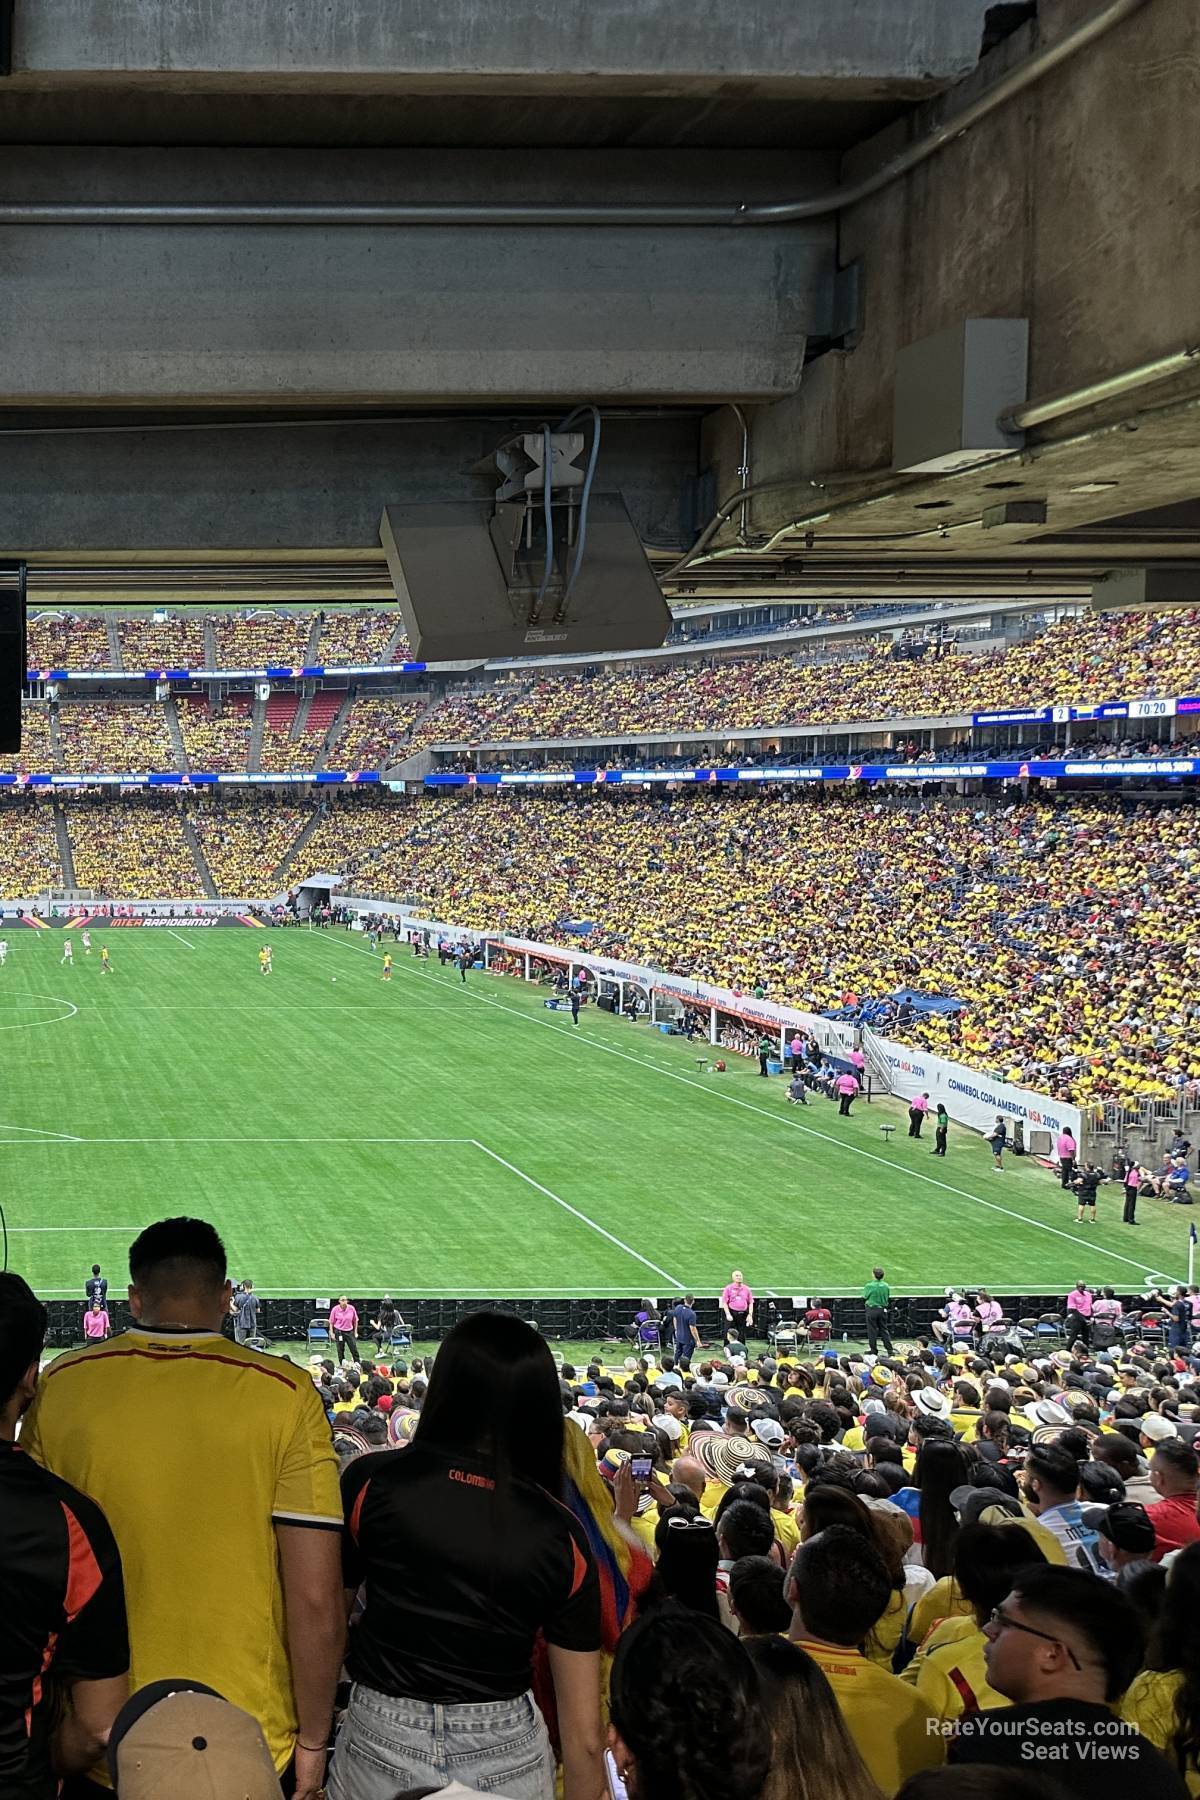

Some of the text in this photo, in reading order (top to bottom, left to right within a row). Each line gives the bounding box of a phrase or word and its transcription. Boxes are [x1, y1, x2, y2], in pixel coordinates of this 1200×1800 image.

[1058, 709, 1064, 720] 2
[1138, 702, 1167, 715] 70:20
[900, 1061, 911, 1073] USA
[911, 1065, 926, 1078] 2024
[947, 1079, 1060, 1131] CONMEBOL COPA AMERICA USA 2024
[449, 1468, 496, 1491] COLOMBIA
